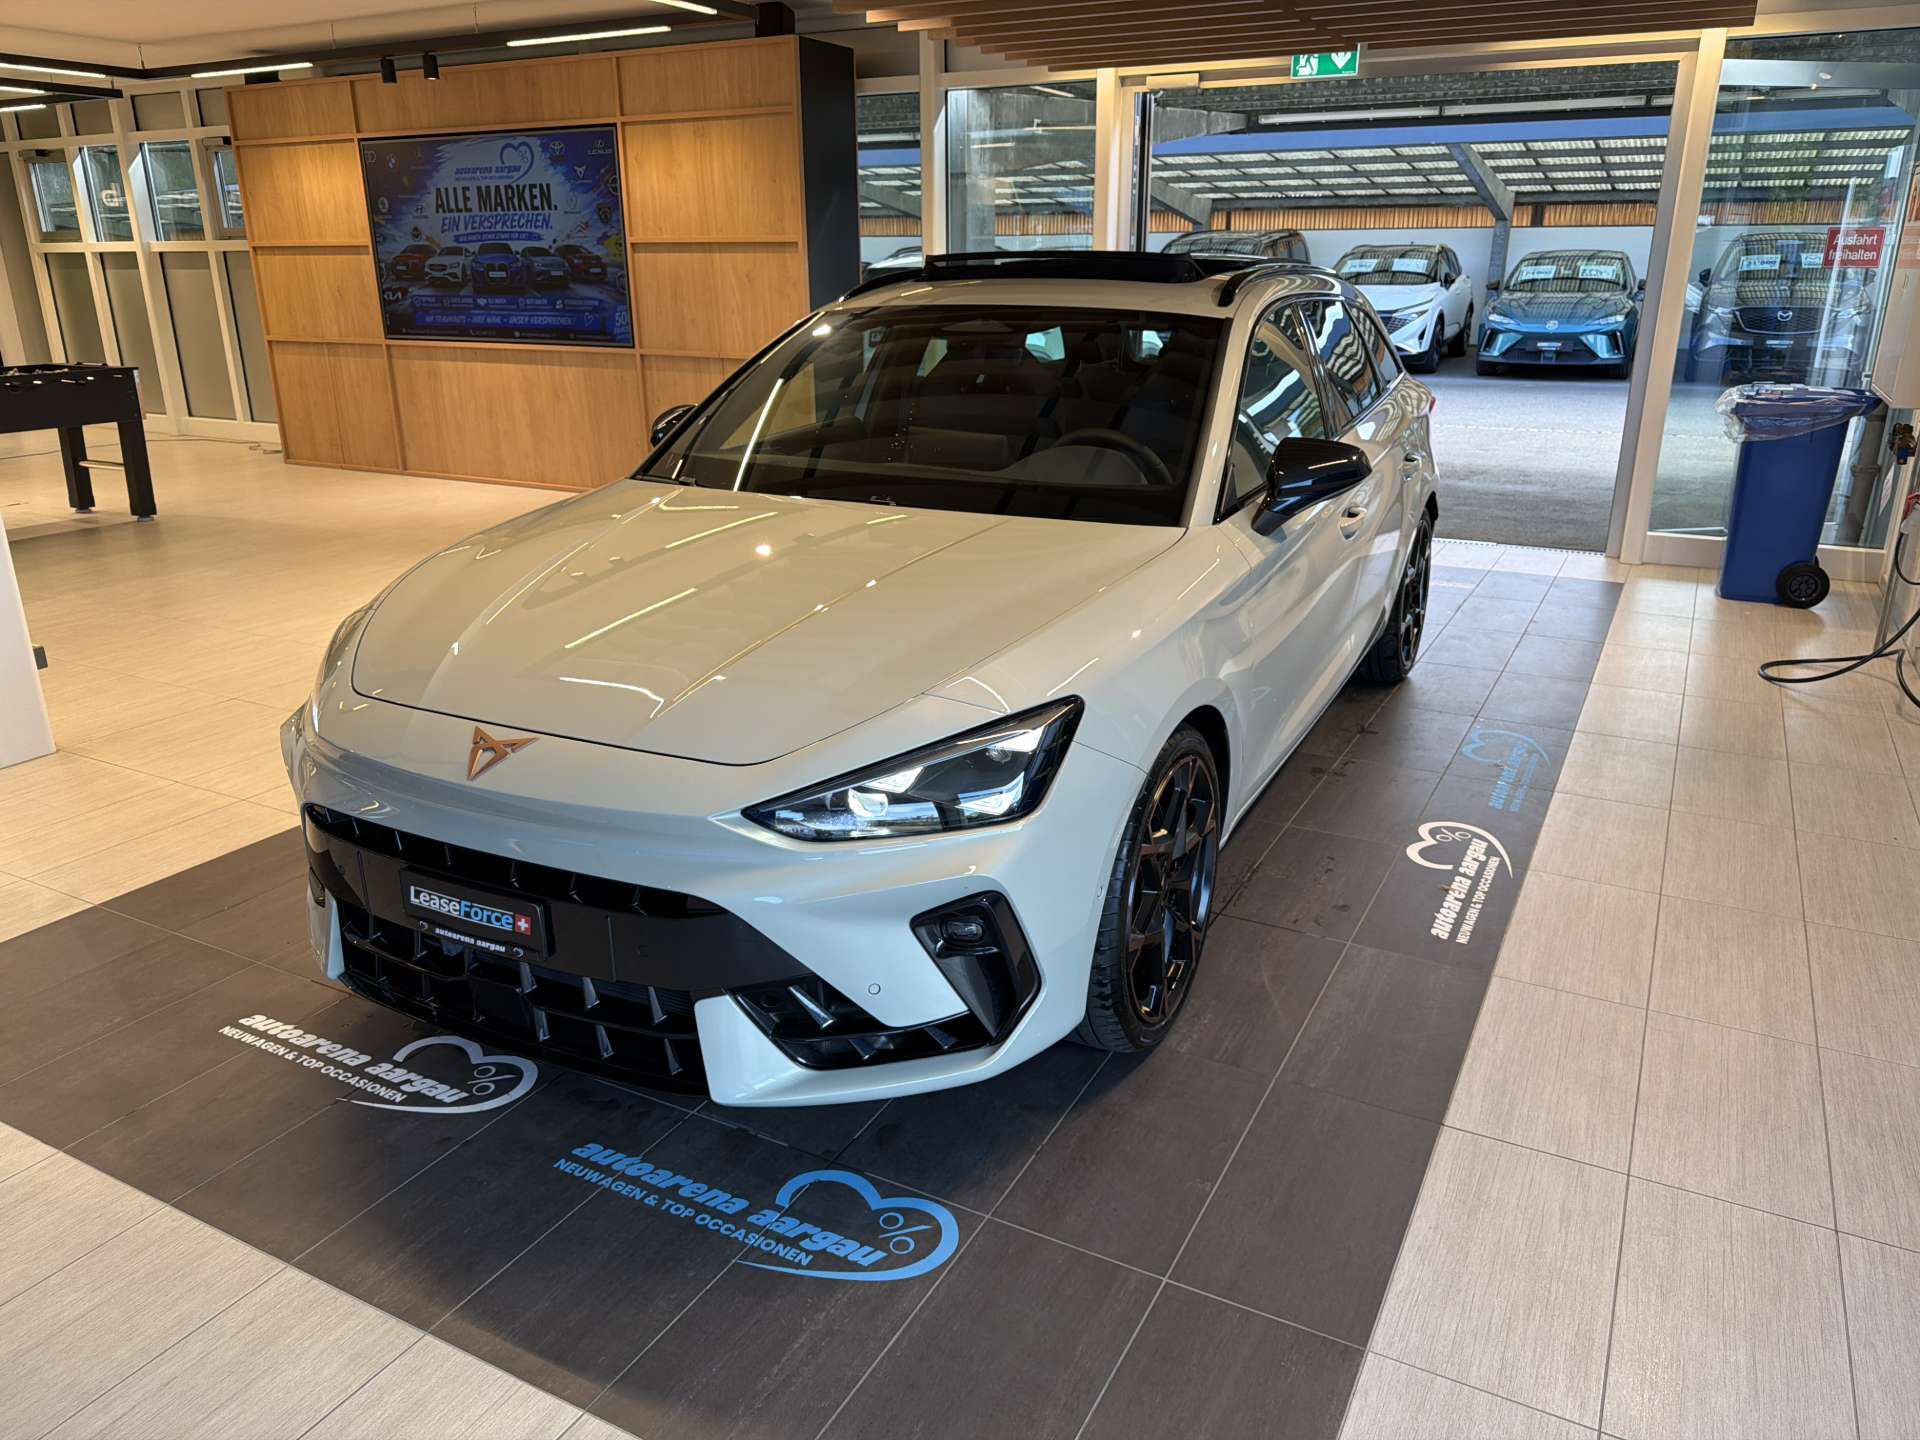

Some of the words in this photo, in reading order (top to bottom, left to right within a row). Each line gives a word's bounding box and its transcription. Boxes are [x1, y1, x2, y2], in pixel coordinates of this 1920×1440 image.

[435, 185, 473, 214] ALLE
[476, 183, 558, 212] MARKEN.
[441, 215, 459, 233] EIN
[462, 213, 553, 232] VERSPRECHEN.
[1828, 248, 1877, 261] freihalten
[1833, 233, 1878, 245] Ausfahrt
[410, 885, 513, 929] LeaseForce
[1431, 875, 1472, 940] autoarena
[1458, 838, 1488, 877] aargau
[435, 927, 475, 945] autoarena
[476, 939, 506, 953] aargau
[1455, 907, 1480, 945] NEUWAGEN
[1473, 887, 1486, 902] TOP
[218, 1025, 289, 1056] NEUWAGEN
[284, 1050, 299, 1061] &
[297, 1054, 325, 1071] TOP
[321, 1065, 407, 1104] OCCASIONEN
[238, 1013, 372, 1067] autoarena
[364, 1060, 471, 1104] aargau
[553, 1158, 647, 1202] NEUWAGEN
[643, 1193, 659, 1206] &
[660, 1199, 696, 1219] TOP
[694, 1213, 813, 1266] OCCASIONEN
[571, 1142, 750, 1215] autoarena
[746, 1208, 888, 1267] aargau
